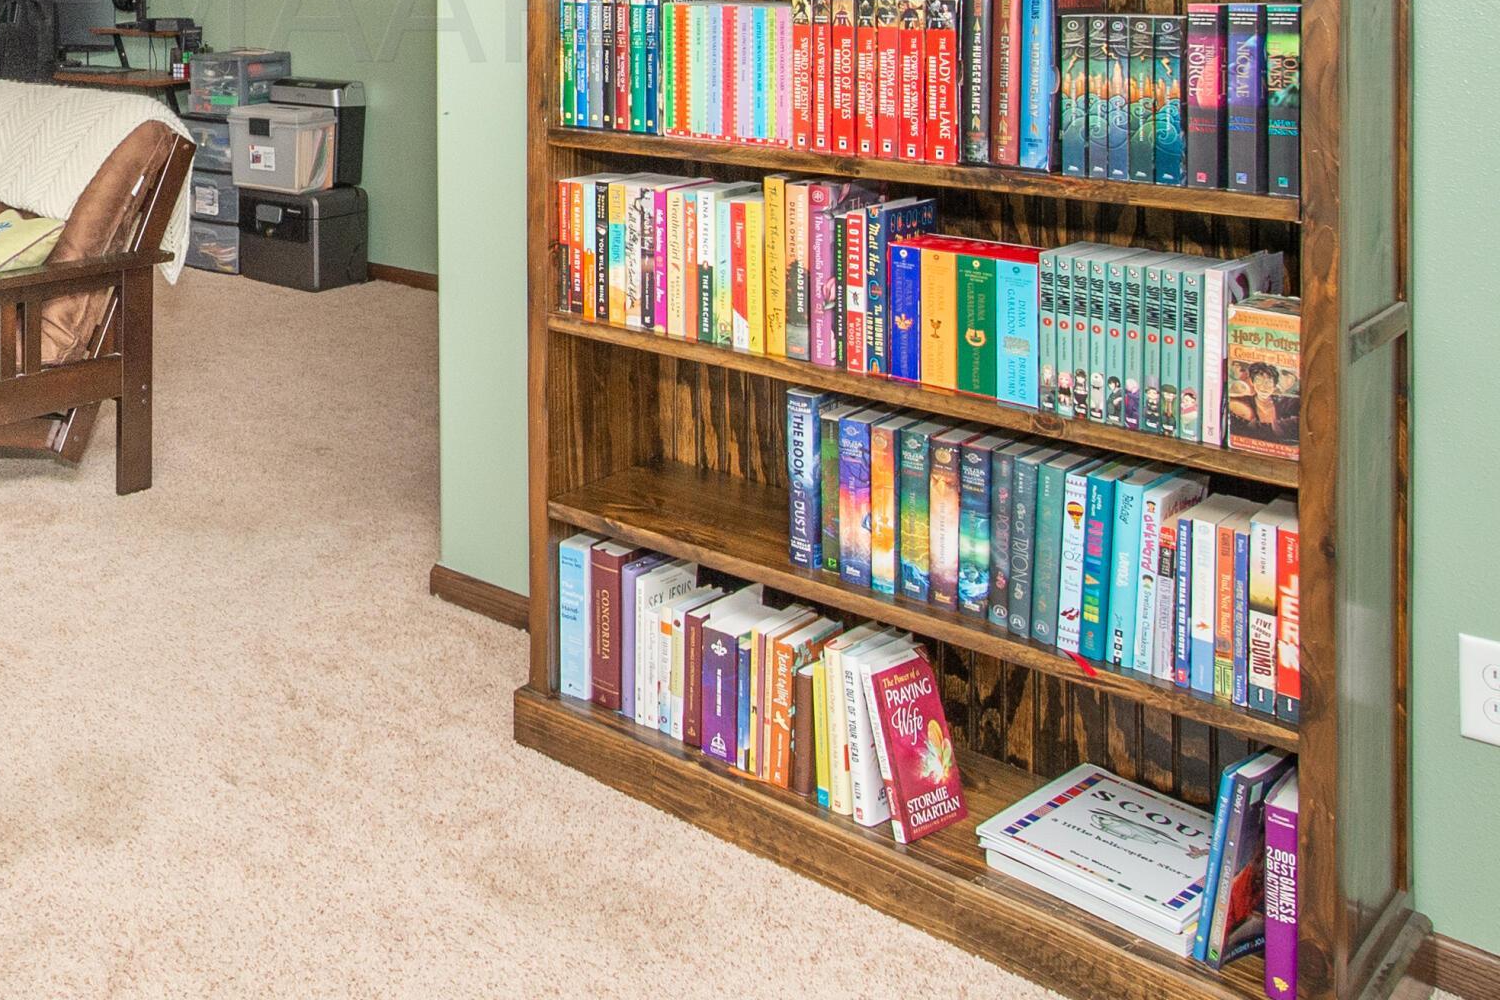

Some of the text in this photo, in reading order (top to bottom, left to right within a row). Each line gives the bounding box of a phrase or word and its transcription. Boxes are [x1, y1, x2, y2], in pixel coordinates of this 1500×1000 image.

[801, 72, 808, 83] OF
[939, 52, 950, 82] LADY
[972, 45, 981, 83] HUNGER
[1000, 36, 1009, 88] CATCHING
[1188, 44, 1204, 96] FORCE
[1236, 41, 1250, 97] NICOLAE
[1268, 41, 1282, 92] HARVEST
[1283, 52, 1298, 87] SOUL
[842, 39, 850, 119] BLOOD OF ELVES
[1030, 41, 1040, 118] MOCKINGJAY
[972, 85, 981, 114] GAMES
[999, 92, 1008, 116] FIRE
[940, 111, 950, 139] LAKE
[815, 215, 823, 230] The
[669, 241, 680, 260] Girl
[812, 233, 823, 270] Magnolia
[849, 219, 860, 279] LOTTERY
[867, 223, 880, 276] Matt Haig
[599, 273, 604, 282] BE
[815, 273, 823, 298] Palace
[1007, 289, 1015, 334] GABALDON
[875, 318, 883, 357] MIDNIGHT
[1233, 329, 1263, 346] Harry
[1007, 359, 1015, 396] AUTUMN
[1018, 358, 1026, 400] DRUMS OF
[793, 415, 805, 534] THE BOOK OF DUST
[1015, 521, 1024, 533] OF
[1011, 537, 1029, 583] TRITON
[1285, 536, 1294, 564] friesen
[1084, 519, 1103, 623] FISH IN A TREE
[1218, 533, 1230, 638] CURTIS Bud, Not Buddy
[1142, 591, 1151, 619] Svetlana
[601, 589, 610, 660] CONCORDIA
[1140, 621, 1149, 657] Chmakova
[1255, 618, 1272, 630] FIVE
[1251, 639, 1271, 677] DUMB
[773, 651, 790, 707] Jesus calling
[845, 670, 853, 685] GET
[882, 676, 894, 689] The
[884, 678, 932, 708] PRAYING
[1234, 675, 1243, 702] Yearling
[846, 688, 854, 703] OUT
[848, 706, 855, 715] OF
[891, 700, 924, 746] Wife
[851, 742, 859, 763] HEAD
[906, 786, 949, 814] STORMIE
[910, 796, 960, 827] OMARTIAN
[1234, 784, 1245, 809] The Daily
[1267, 846, 1296, 865] 2000
[1267, 858, 1296, 880] BEST
[1266, 870, 1278, 921] ACTIVITIES
[1279, 876, 1296, 924] GAMES &
